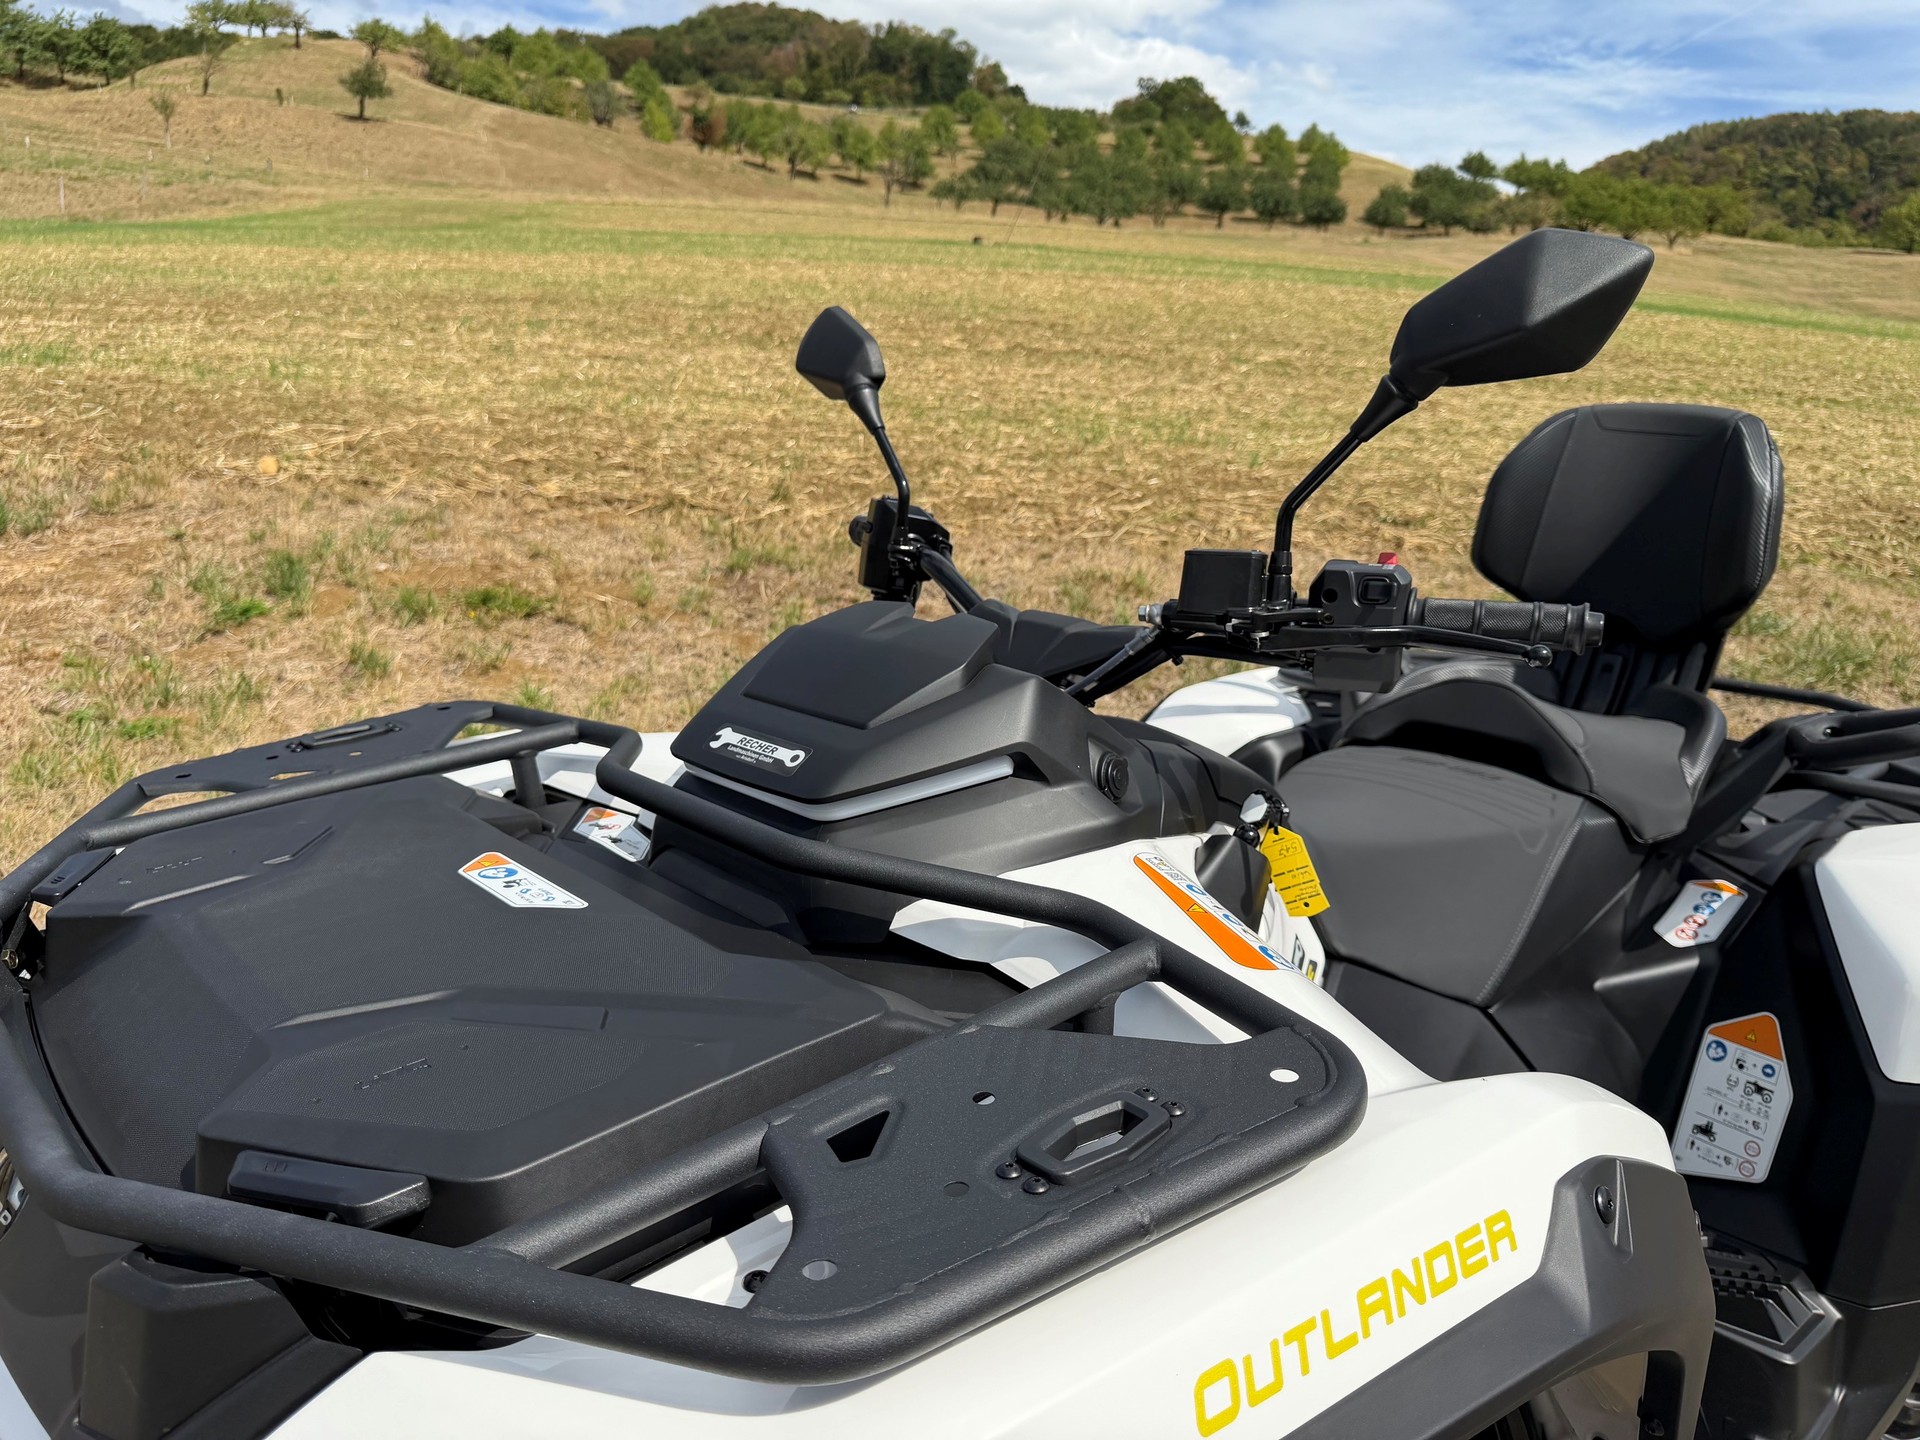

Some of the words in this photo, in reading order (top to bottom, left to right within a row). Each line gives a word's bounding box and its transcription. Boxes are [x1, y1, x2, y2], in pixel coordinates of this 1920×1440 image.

[736, 736, 779, 755] RECHER
[758, 754, 775, 763] GmbH
[1194, 1209, 1518, 1438] OUTLANDER
